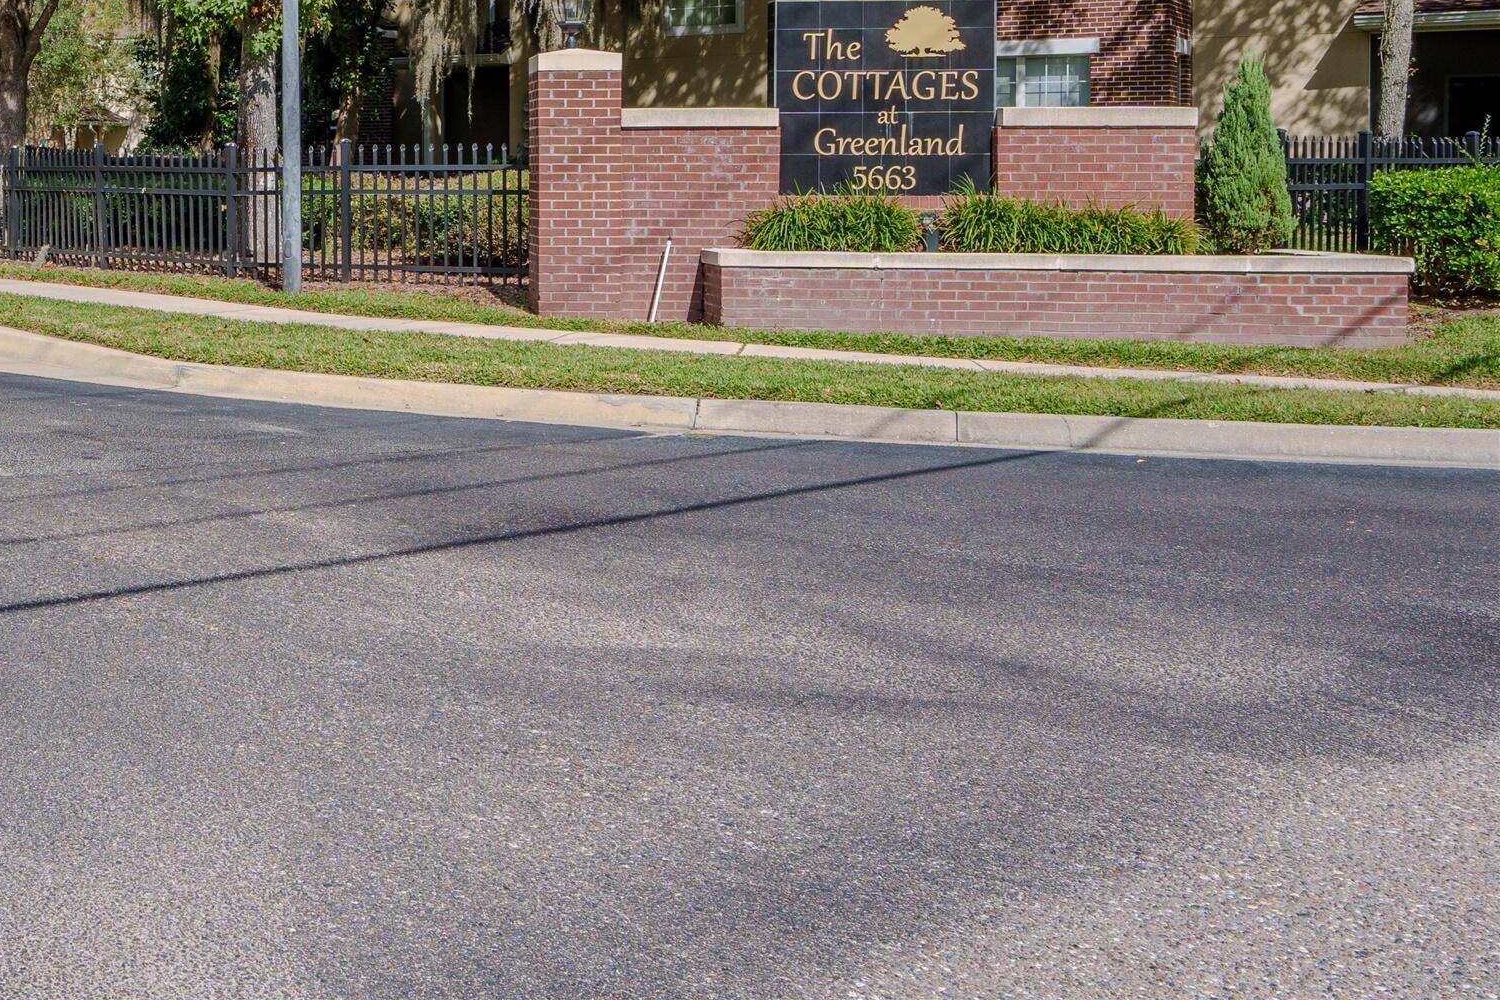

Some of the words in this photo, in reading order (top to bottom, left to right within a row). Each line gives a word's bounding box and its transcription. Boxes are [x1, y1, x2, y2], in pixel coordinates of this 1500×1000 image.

[803, 28, 861, 60] The
[792, 70, 979, 101] COTTAGES
[877, 105, 899, 125] at
[813, 124, 966, 156] Greenland
[852, 165, 917, 190] 5663
